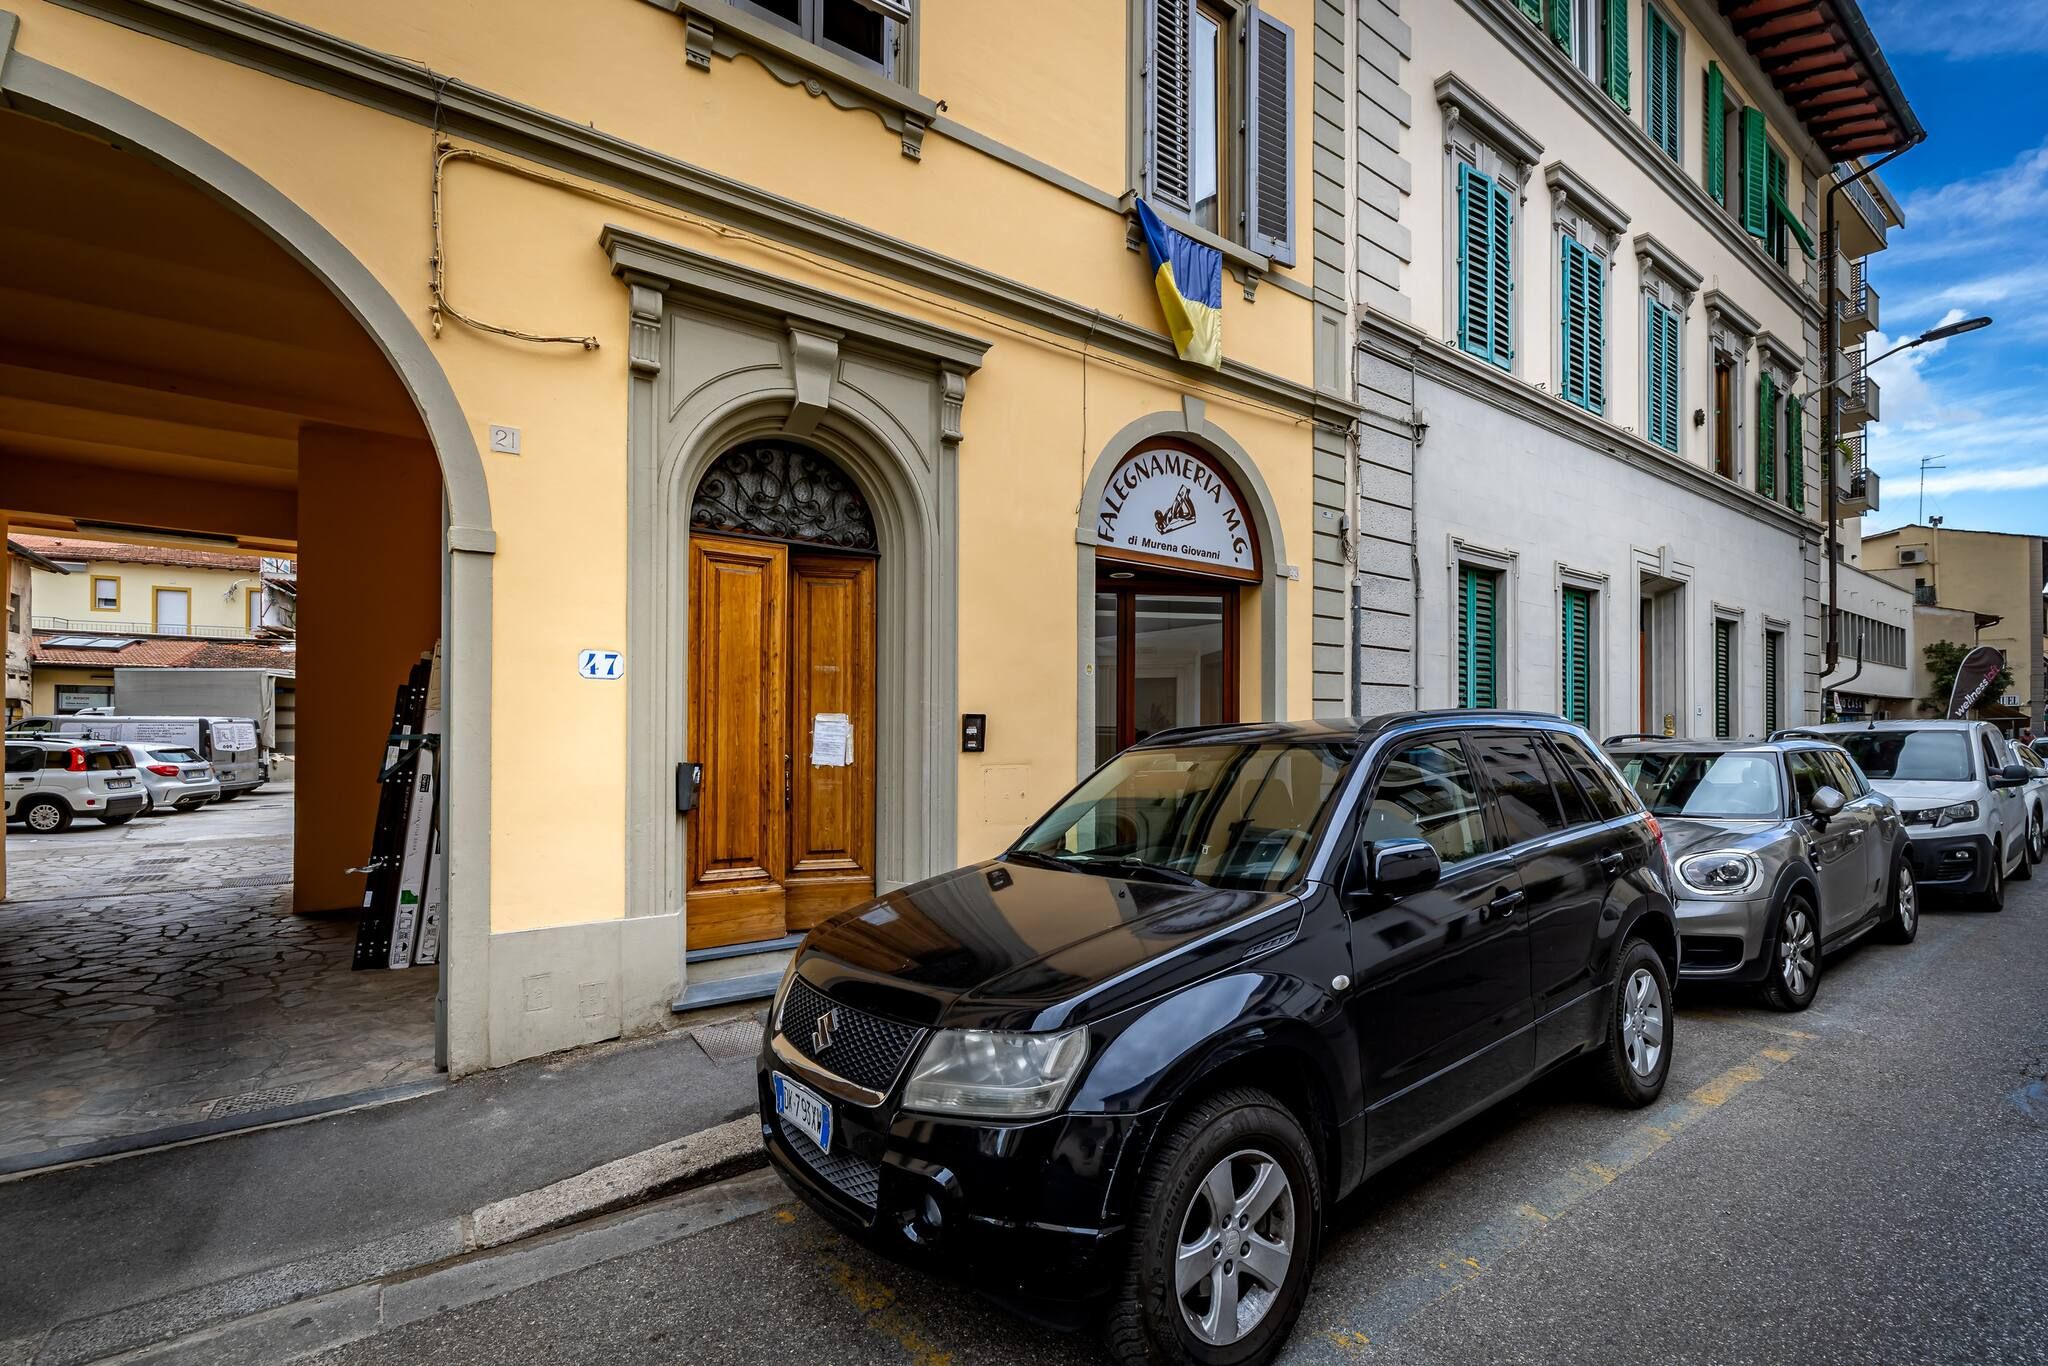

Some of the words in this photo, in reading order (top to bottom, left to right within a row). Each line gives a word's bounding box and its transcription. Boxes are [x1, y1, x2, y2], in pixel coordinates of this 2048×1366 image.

[494, 429, 516, 449] 21
[1097, 454, 1222, 543] FALEGNAMERIA
[1127, 535, 1138, 546] di
[1141, 537, 1178, 553] Murena
[1181, 544, 1221, 560] Giovanni
[582, 653, 619, 676] 47
